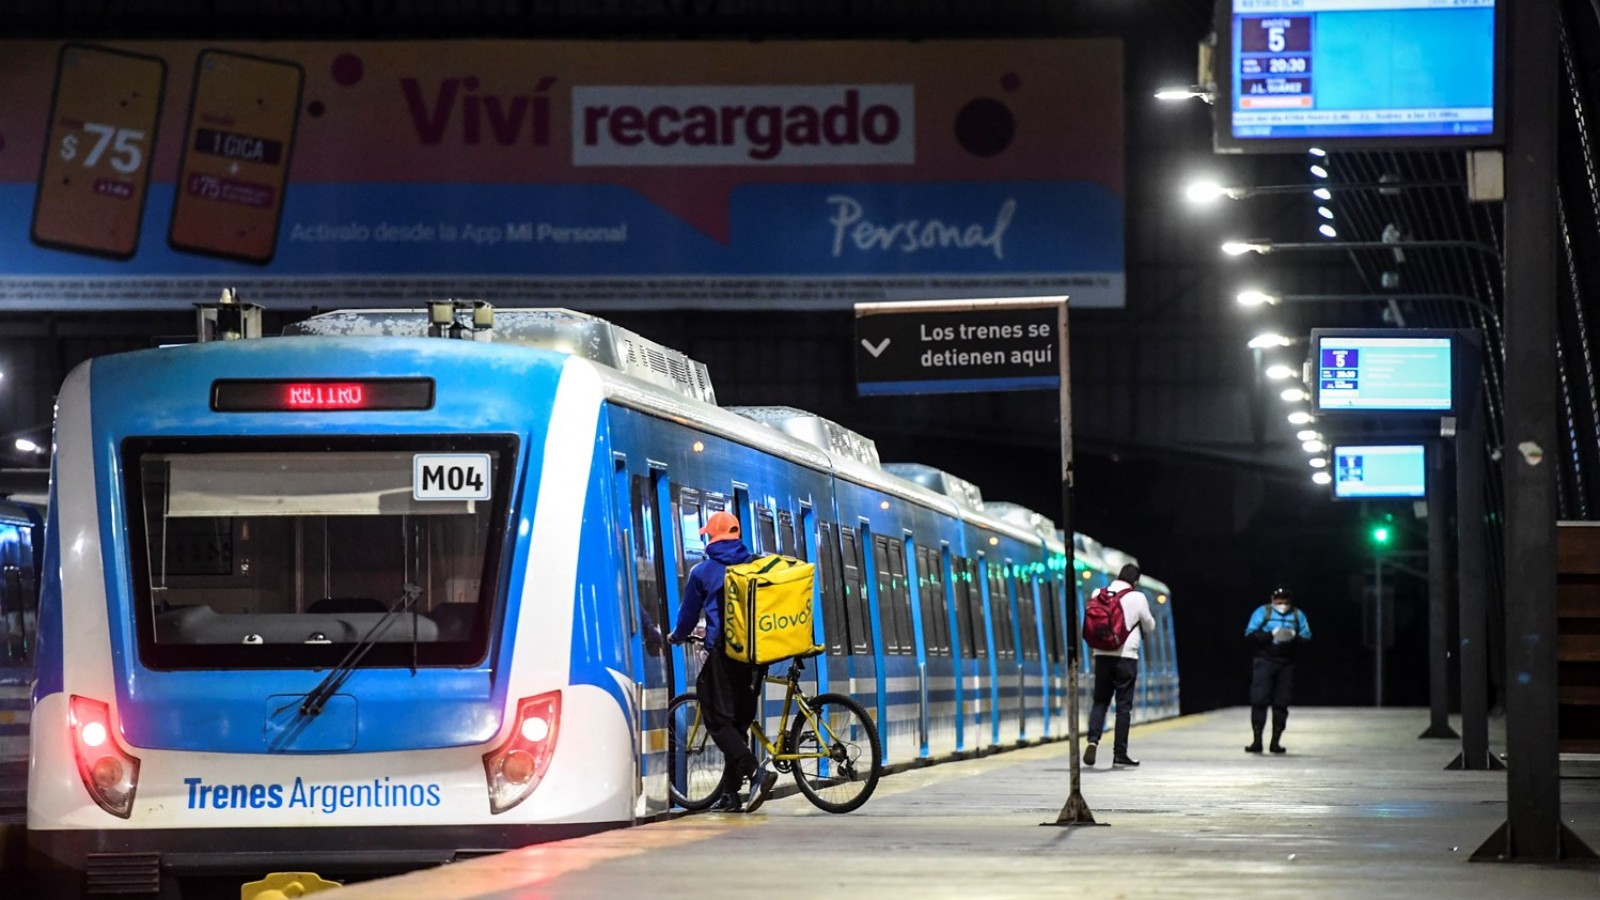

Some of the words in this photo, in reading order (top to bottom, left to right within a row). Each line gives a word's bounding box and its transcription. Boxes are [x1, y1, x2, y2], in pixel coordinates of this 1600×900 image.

[1268, 27, 1285, 52] 5
[1270, 58, 1306, 73] 20:30
[401, 75, 557, 146] Viví
[583, 88, 899, 161] recargado
[373, 223, 435, 242] desde
[439, 223, 457, 242] la
[461, 224, 502, 245] App
[506, 222, 532, 242] Mi
[537, 222, 627, 243] Personal
[826, 194, 1018, 260] Personal
[920, 324, 955, 341] Los
[959, 323, 1023, 340] trenes
[1028, 323, 1051, 337] se
[921, 349, 1005, 367] detienen
[1010, 344, 1052, 367] aquí
[422, 465, 484, 491] M04
[184, 777, 283, 809] Trenes
[289, 776, 441, 814] Argentinos
